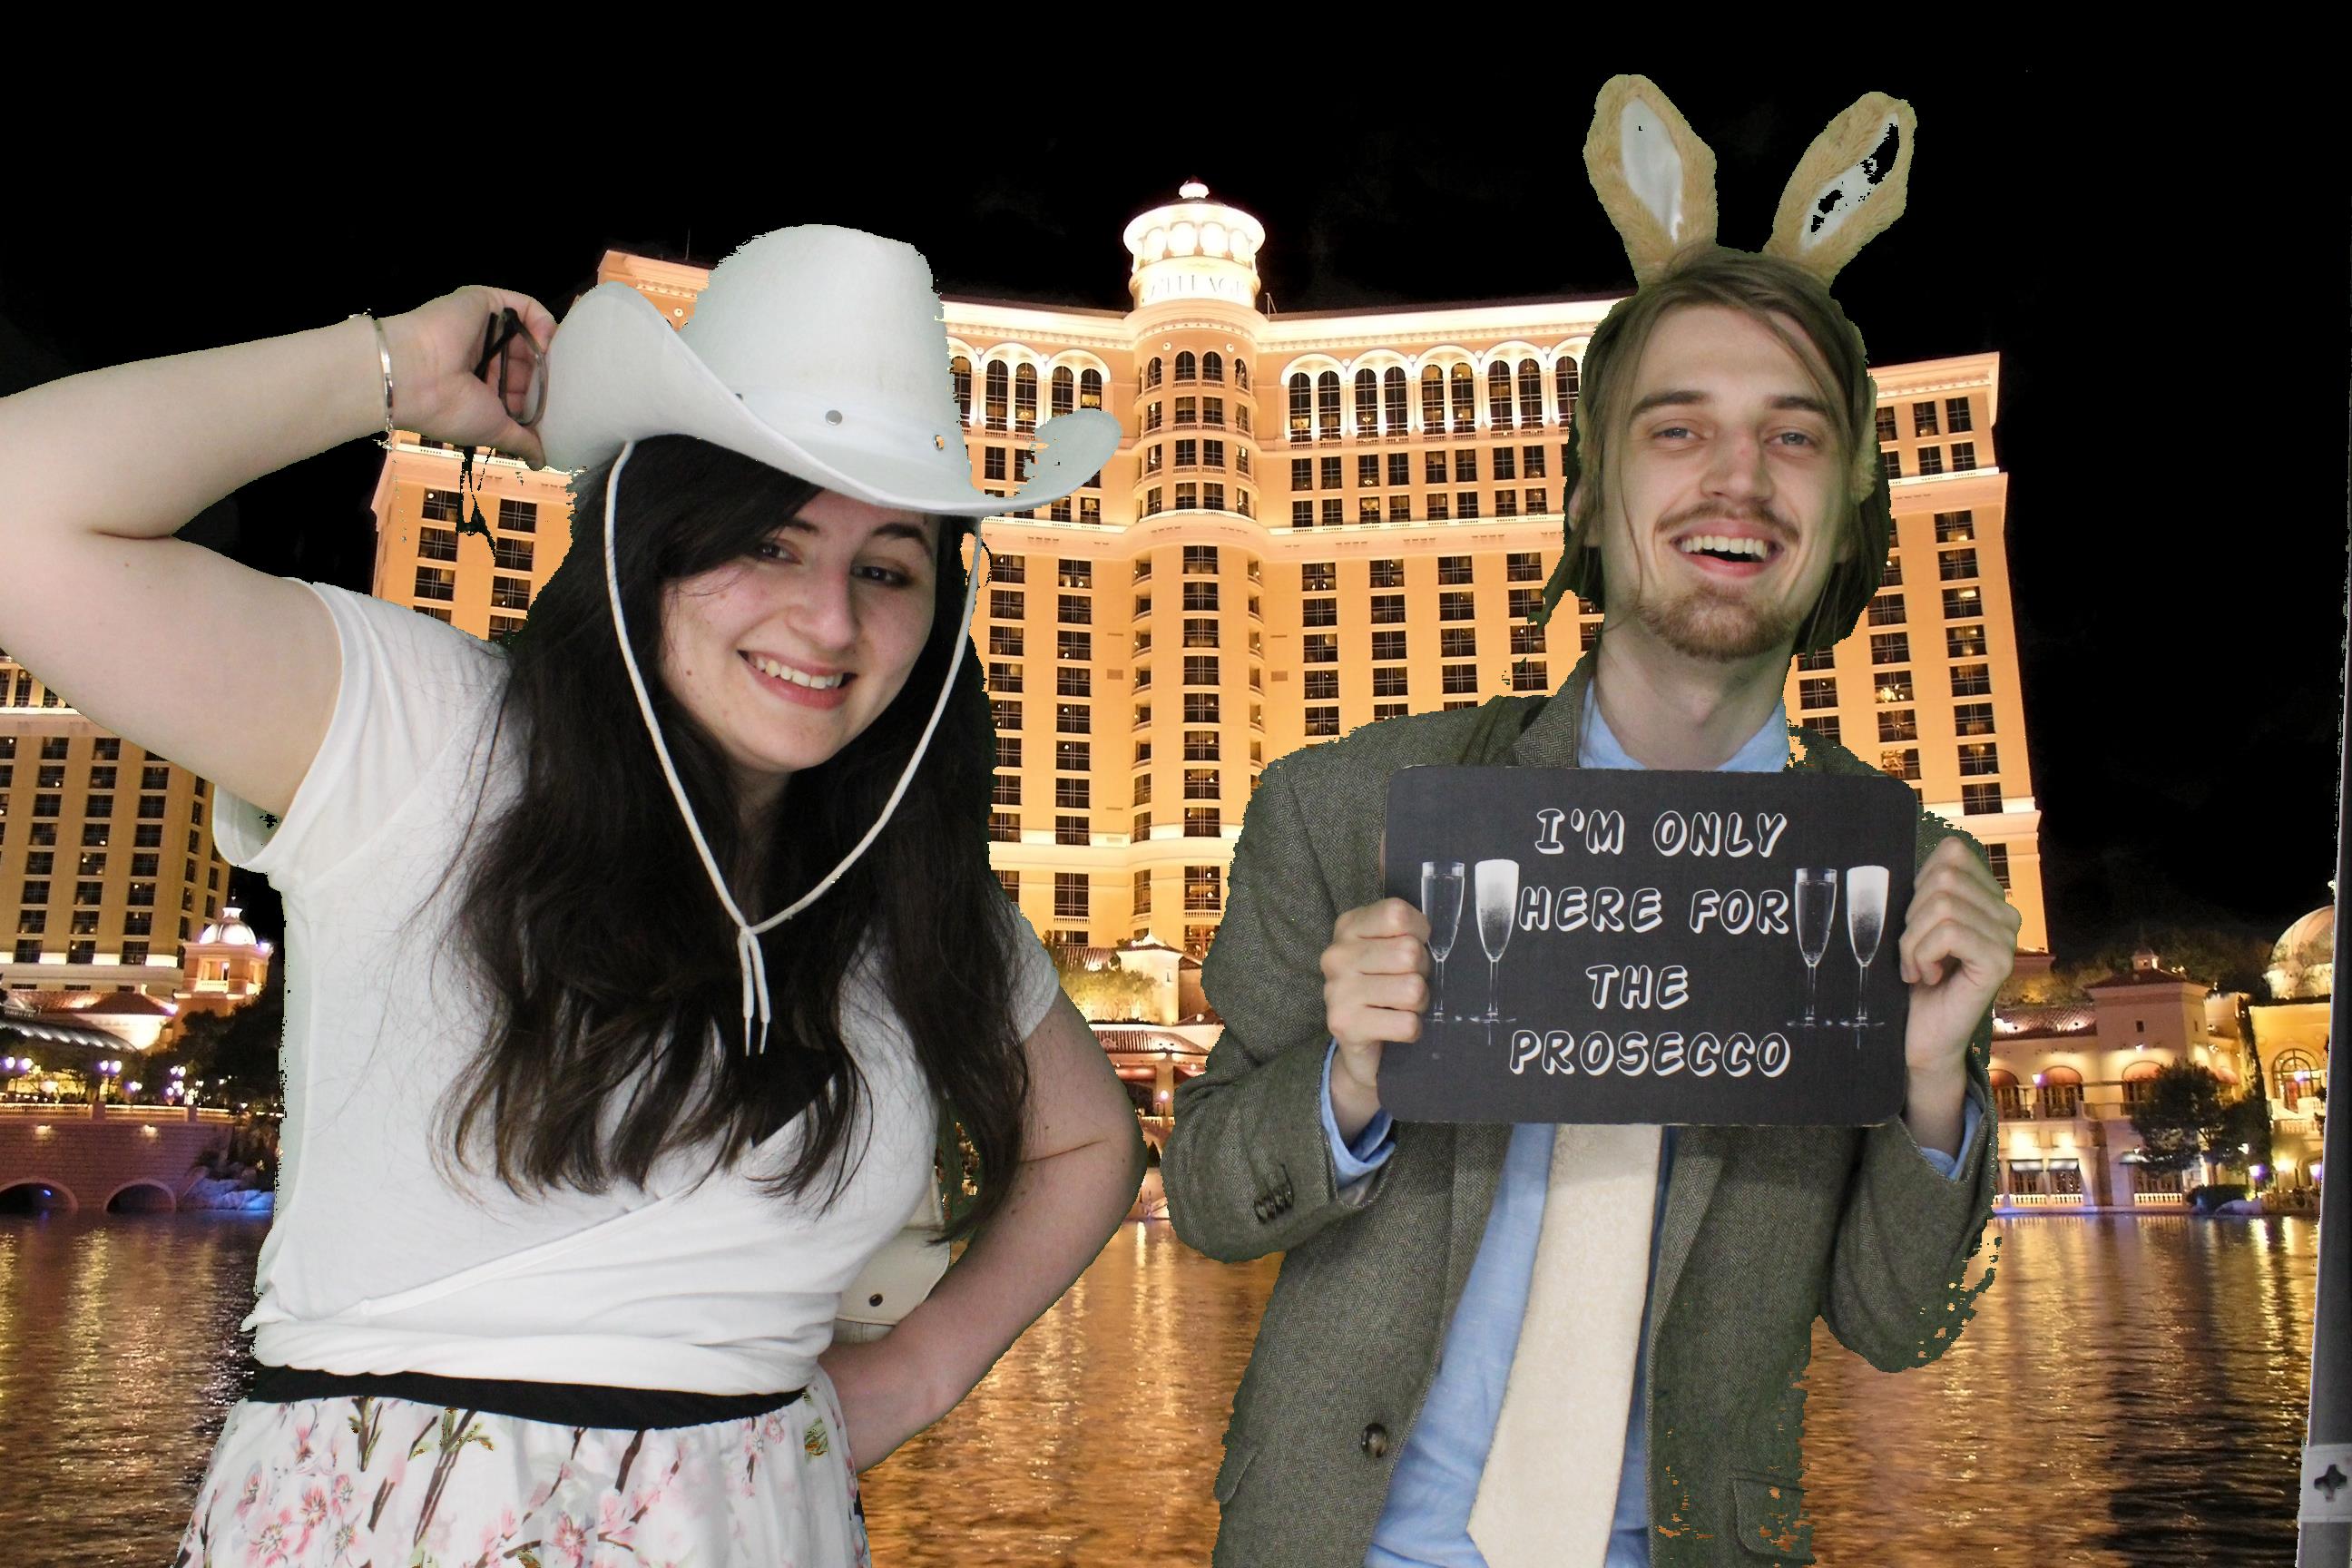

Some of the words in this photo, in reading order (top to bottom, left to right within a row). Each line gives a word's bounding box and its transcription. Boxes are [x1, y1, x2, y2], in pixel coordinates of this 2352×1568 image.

[1534, 808, 1624, 855] I'M
[1652, 810, 1788, 858] ONLY
[1519, 887, 1663, 933] HERE
[1690, 888, 1789, 935] FOR
[1585, 965, 1689, 1010] THE
[1510, 1030, 1791, 1077] PROSECCO
